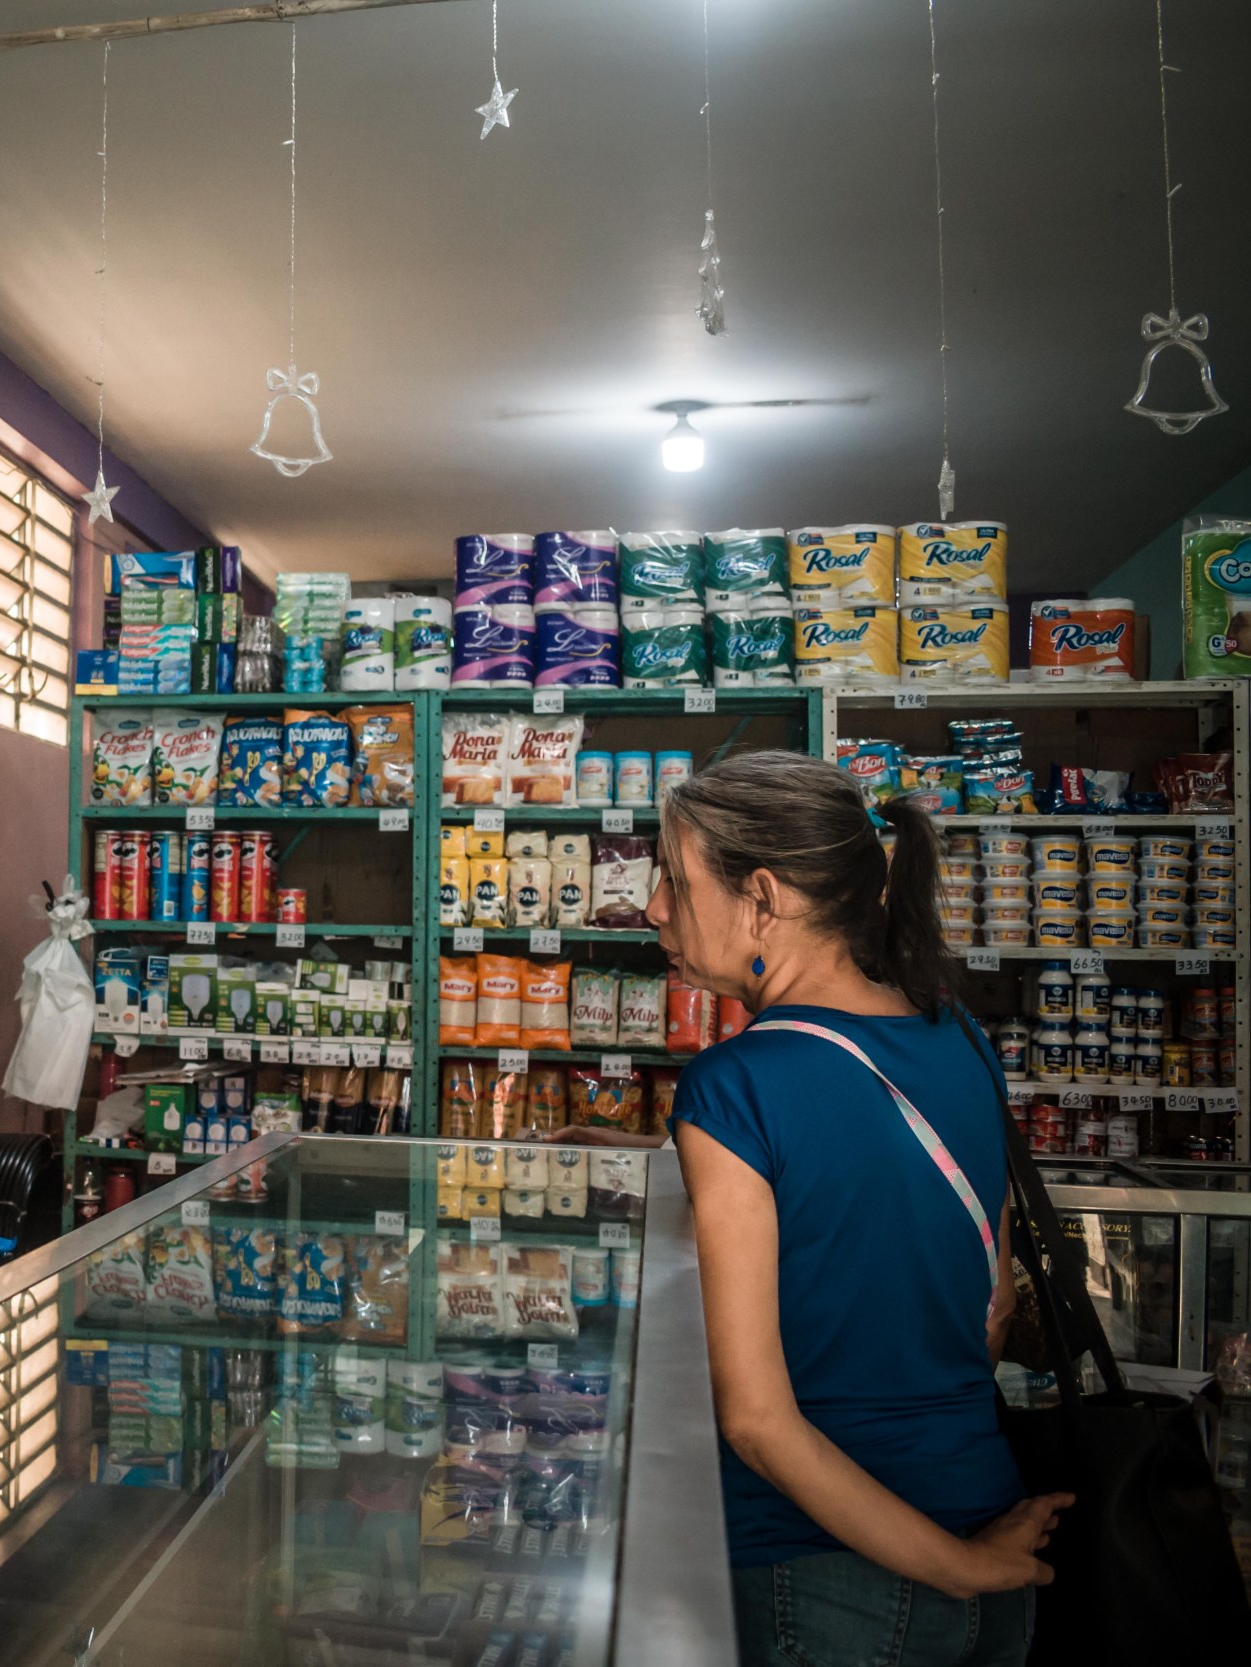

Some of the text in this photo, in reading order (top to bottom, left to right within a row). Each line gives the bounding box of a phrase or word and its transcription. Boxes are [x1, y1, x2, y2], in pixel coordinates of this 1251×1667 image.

[802, 547, 871, 574] Rosal
[922, 541, 992, 567] Rosal
[803, 621, 870, 649] Rosal
[916, 623, 988, 650] Rosal
[1051, 622, 1127, 653] Rosal
[1225, 639, 1237, 649] 50
[632, 641, 692, 668] Rosal
[100, 726, 154, 745] Cronch
[161, 725, 216, 747] Cronch
[104, 743, 147, 756] Flakes
[167, 742, 211, 758] Flakes
[1048, 850, 1076, 860] mavesa
[1095, 852, 1130, 861] mavesa
[475, 884, 499, 897] PAN
[517, 890, 541, 903] PAN
[558, 888, 583, 900] PAN
[1042, 889, 1076, 899] mavesa
[1097, 889, 1127, 899] mavesa
[1040, 925, 1074, 936] mavesa
[1091, 925, 1126, 936] mavesa
[101, 968, 133, 977] ZETTA
[443, 981, 474, 994] Mary
[485, 979, 517, 992] Mary
[529, 984, 562, 997] Mary
